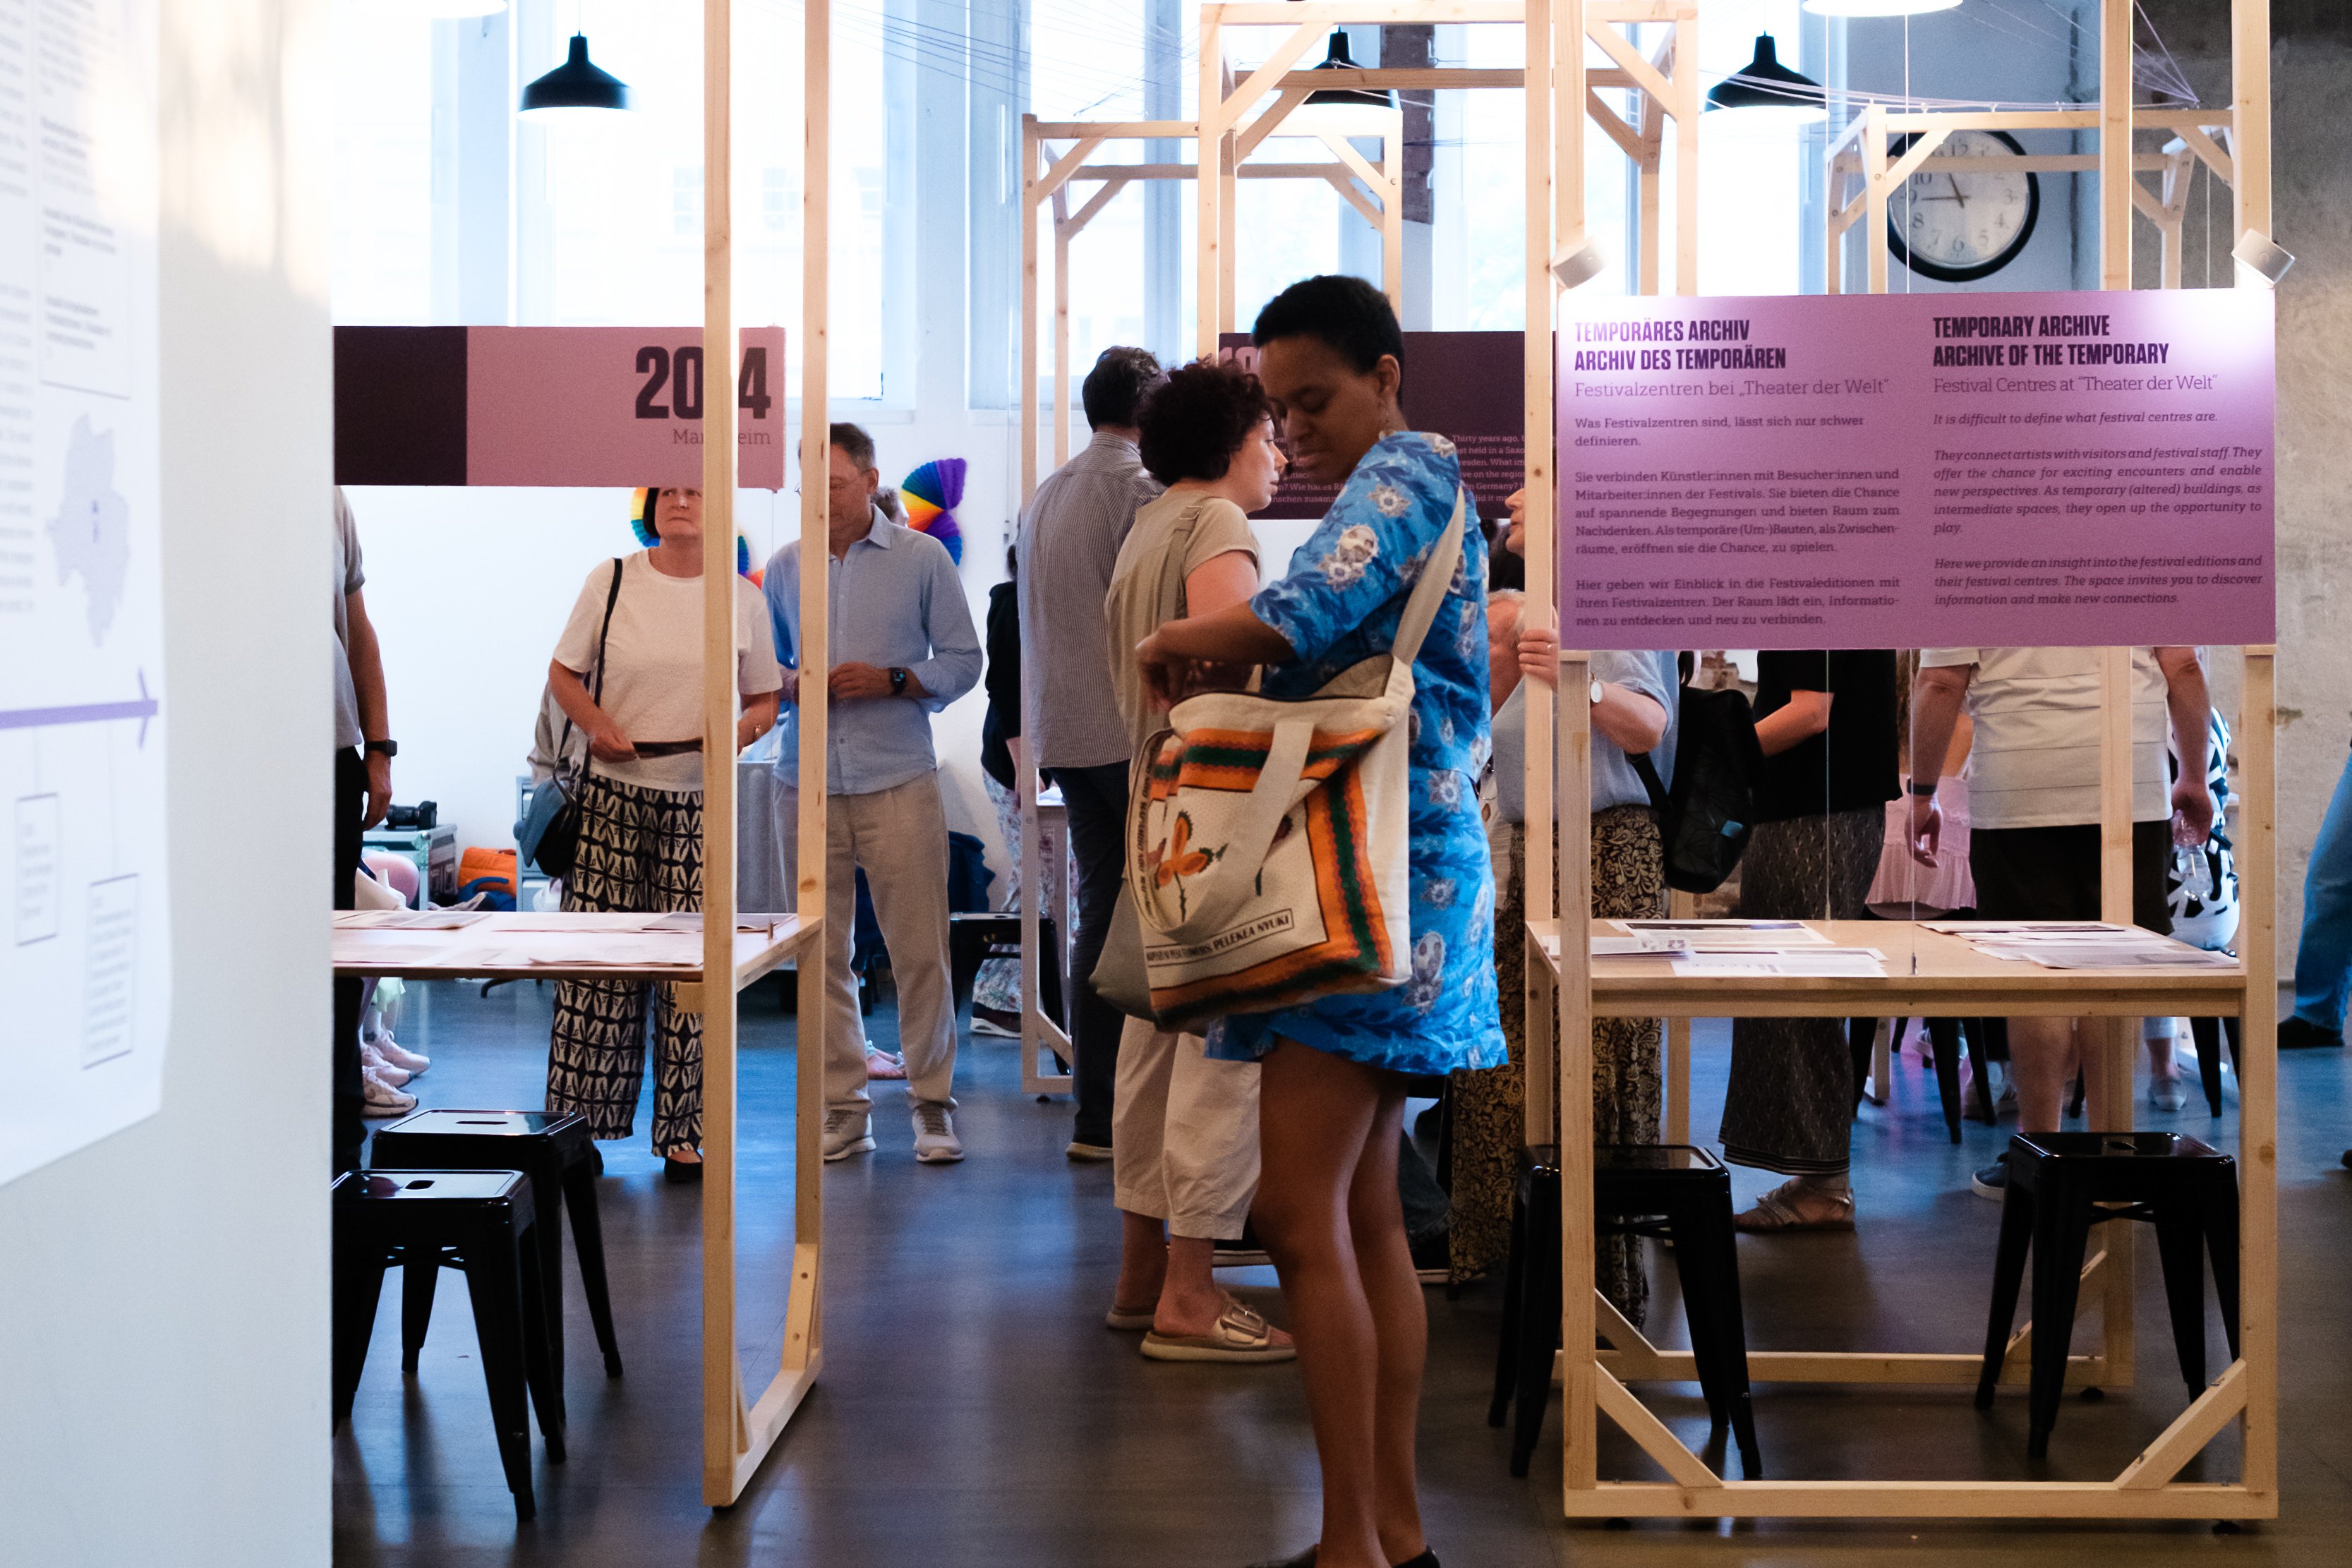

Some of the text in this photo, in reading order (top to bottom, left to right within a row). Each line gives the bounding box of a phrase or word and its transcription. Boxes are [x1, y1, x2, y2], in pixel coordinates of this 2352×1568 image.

[1575, 318, 1750, 342] TEMPORÄRES ARCHIV
[1933, 315, 2110, 338] TEMPORARY ARCHIVE
[1574, 344, 1786, 371] ARCHIV DES TEMPORÄREN
[1933, 343, 2169, 367] ARCHIVE OF THE TEMPORARY
[636, 346, 771, 419] 204
[1575, 380, 1703, 398] Festivalzentren
[1708, 381, 1735, 396] bei
[1813, 379, 1840, 394] der
[1934, 377, 1993, 393] Festival
[1996, 377, 2056, 392] Centres
[2060, 378, 2075, 391] at
[2147, 375, 2173, 390] der
[1575, 418, 1600, 428] Was
[1605, 418, 1698, 428] Festivalzentren
[1735, 416, 1764, 427] lässt
[1767, 416, 1792, 426] sich
[1795, 417, 1816, 426] nur
[1820, 415, 1864, 426] schwer
[1934, 414, 1942, 424] It
[1946, 414, 1955, 424] is
[1958, 413, 2007, 426] difficult
[2010, 414, 2022, 423] to
[2025, 413, 2063, 426] define
[2065, 412, 2097, 423] what
[2099, 412, 2145, 425] festival
[2148, 413, 2193, 422] centres
[673, 428, 771, 445] Maeim
[1452, 434, 1477, 443] Thirty
[1478, 435, 1501, 444] years
[1575, 436, 1641, 447] definieren.
[1934, 450, 1962, 463] They
[1964, 450, 2012, 460] connect
[2013, 450, 2052, 459] artists
[2054, 449, 2080, 459] with
[2082, 449, 2126, 459] visitors
[2128, 448, 2152, 458] and
[2153, 447, 2199, 460] festival
[2232, 447, 2262, 459] They
[1934, 465, 2262, 481] offer the chance for exciting encounters and enable
[1476, 482, 1518, 492] Germany?
[1934, 488, 1960, 497] new
[2044, 486, 2058, 495] As
[2062, 486, 2127, 497] temporary
[2129, 483, 2180, 496] (altered)
[2247, 485, 2262, 493] as
[1575, 506, 1900, 520] auf spannende Begegnungen und bieten Raum zum
[1934, 504, 2012, 514] intermediate
[2065, 502, 2092, 516] they
[2096, 504, 2125, 516] open
[2130, 504, 2146, 515] up
[2150, 502, 2169, 512] the
[2173, 501, 2246, 514] opportunity
[2250, 502, 2262, 512] to
[1934, 555, 2262, 571] Here we provide an insight into the festival editions and
[1576, 577, 1900, 592] Hier geben wir Einblick in die Festivaleditionen mit
[1934, 576, 1962, 586] their
[1965, 576, 2010, 589] festival
[2064, 575, 2086, 586] The
[2089, 577, 2124, 588] space
[2128, 574, 2168, 585] invites
[2171, 576, 2193, 587] you
[2197, 574, 2208, 584] to
[2212, 574, 2263, 584] discover
[1576, 598, 1608, 608] ihren
[1712, 597, 1735, 607] Der
[1737, 596, 1773, 607] Raum
[1776, 596, 1799, 606] lädt
[1935, 594, 2007, 608] information
[2010, 593, 2034, 604] and
[2037, 593, 2071, 604] make
[2074, 595, 2101, 604] new
